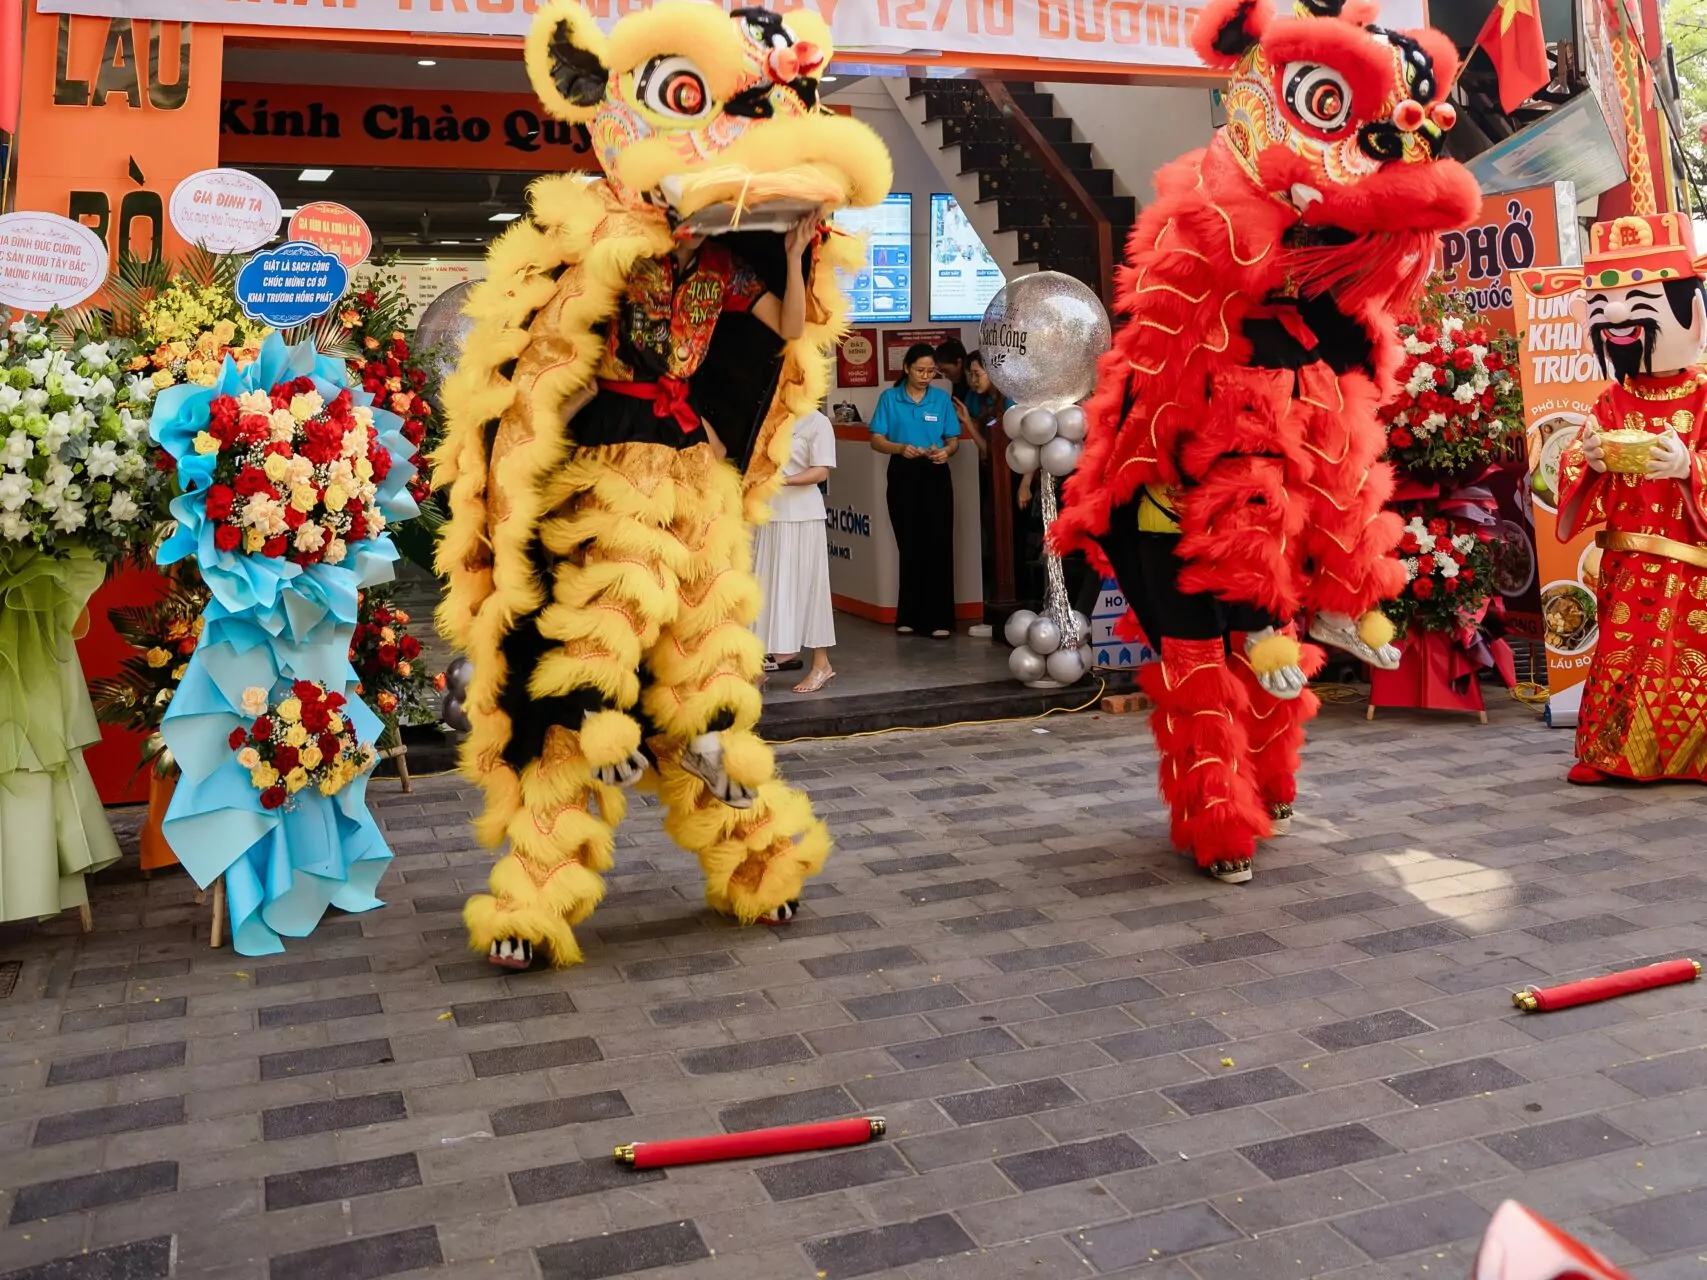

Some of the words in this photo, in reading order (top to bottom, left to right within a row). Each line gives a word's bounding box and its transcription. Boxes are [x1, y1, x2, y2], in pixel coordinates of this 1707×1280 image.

[220, 99, 341, 138] Kính
[362, 104, 491, 142] Chào
[193, 189, 213, 205] GIA
[249, 198, 263, 211] TA
[1439, 198, 1535, 282] PHỞ
[32, 271, 54, 283] KHAI
[263, 259, 280, 272] GIẶT
[281, 259, 290, 271] LÀ
[292, 261, 311, 274] SẠCH
[263, 275, 283, 287] CHÚC
[285, 275, 306, 287] MỪNG
[306, 276, 317, 287] CƠ
[248, 292, 265, 303] KHAI
[267, 292, 294, 303] TRƯƠNG
[315, 290, 334, 303] PHÁT
[1464, 279, 1513, 314] QUỐC
[1000, 324, 1028, 356] Cộng
[1528, 322, 1583, 352] KHAI
[1531, 398, 1554, 416] PHỞ
[1556, 397, 1570, 408] LÝ
